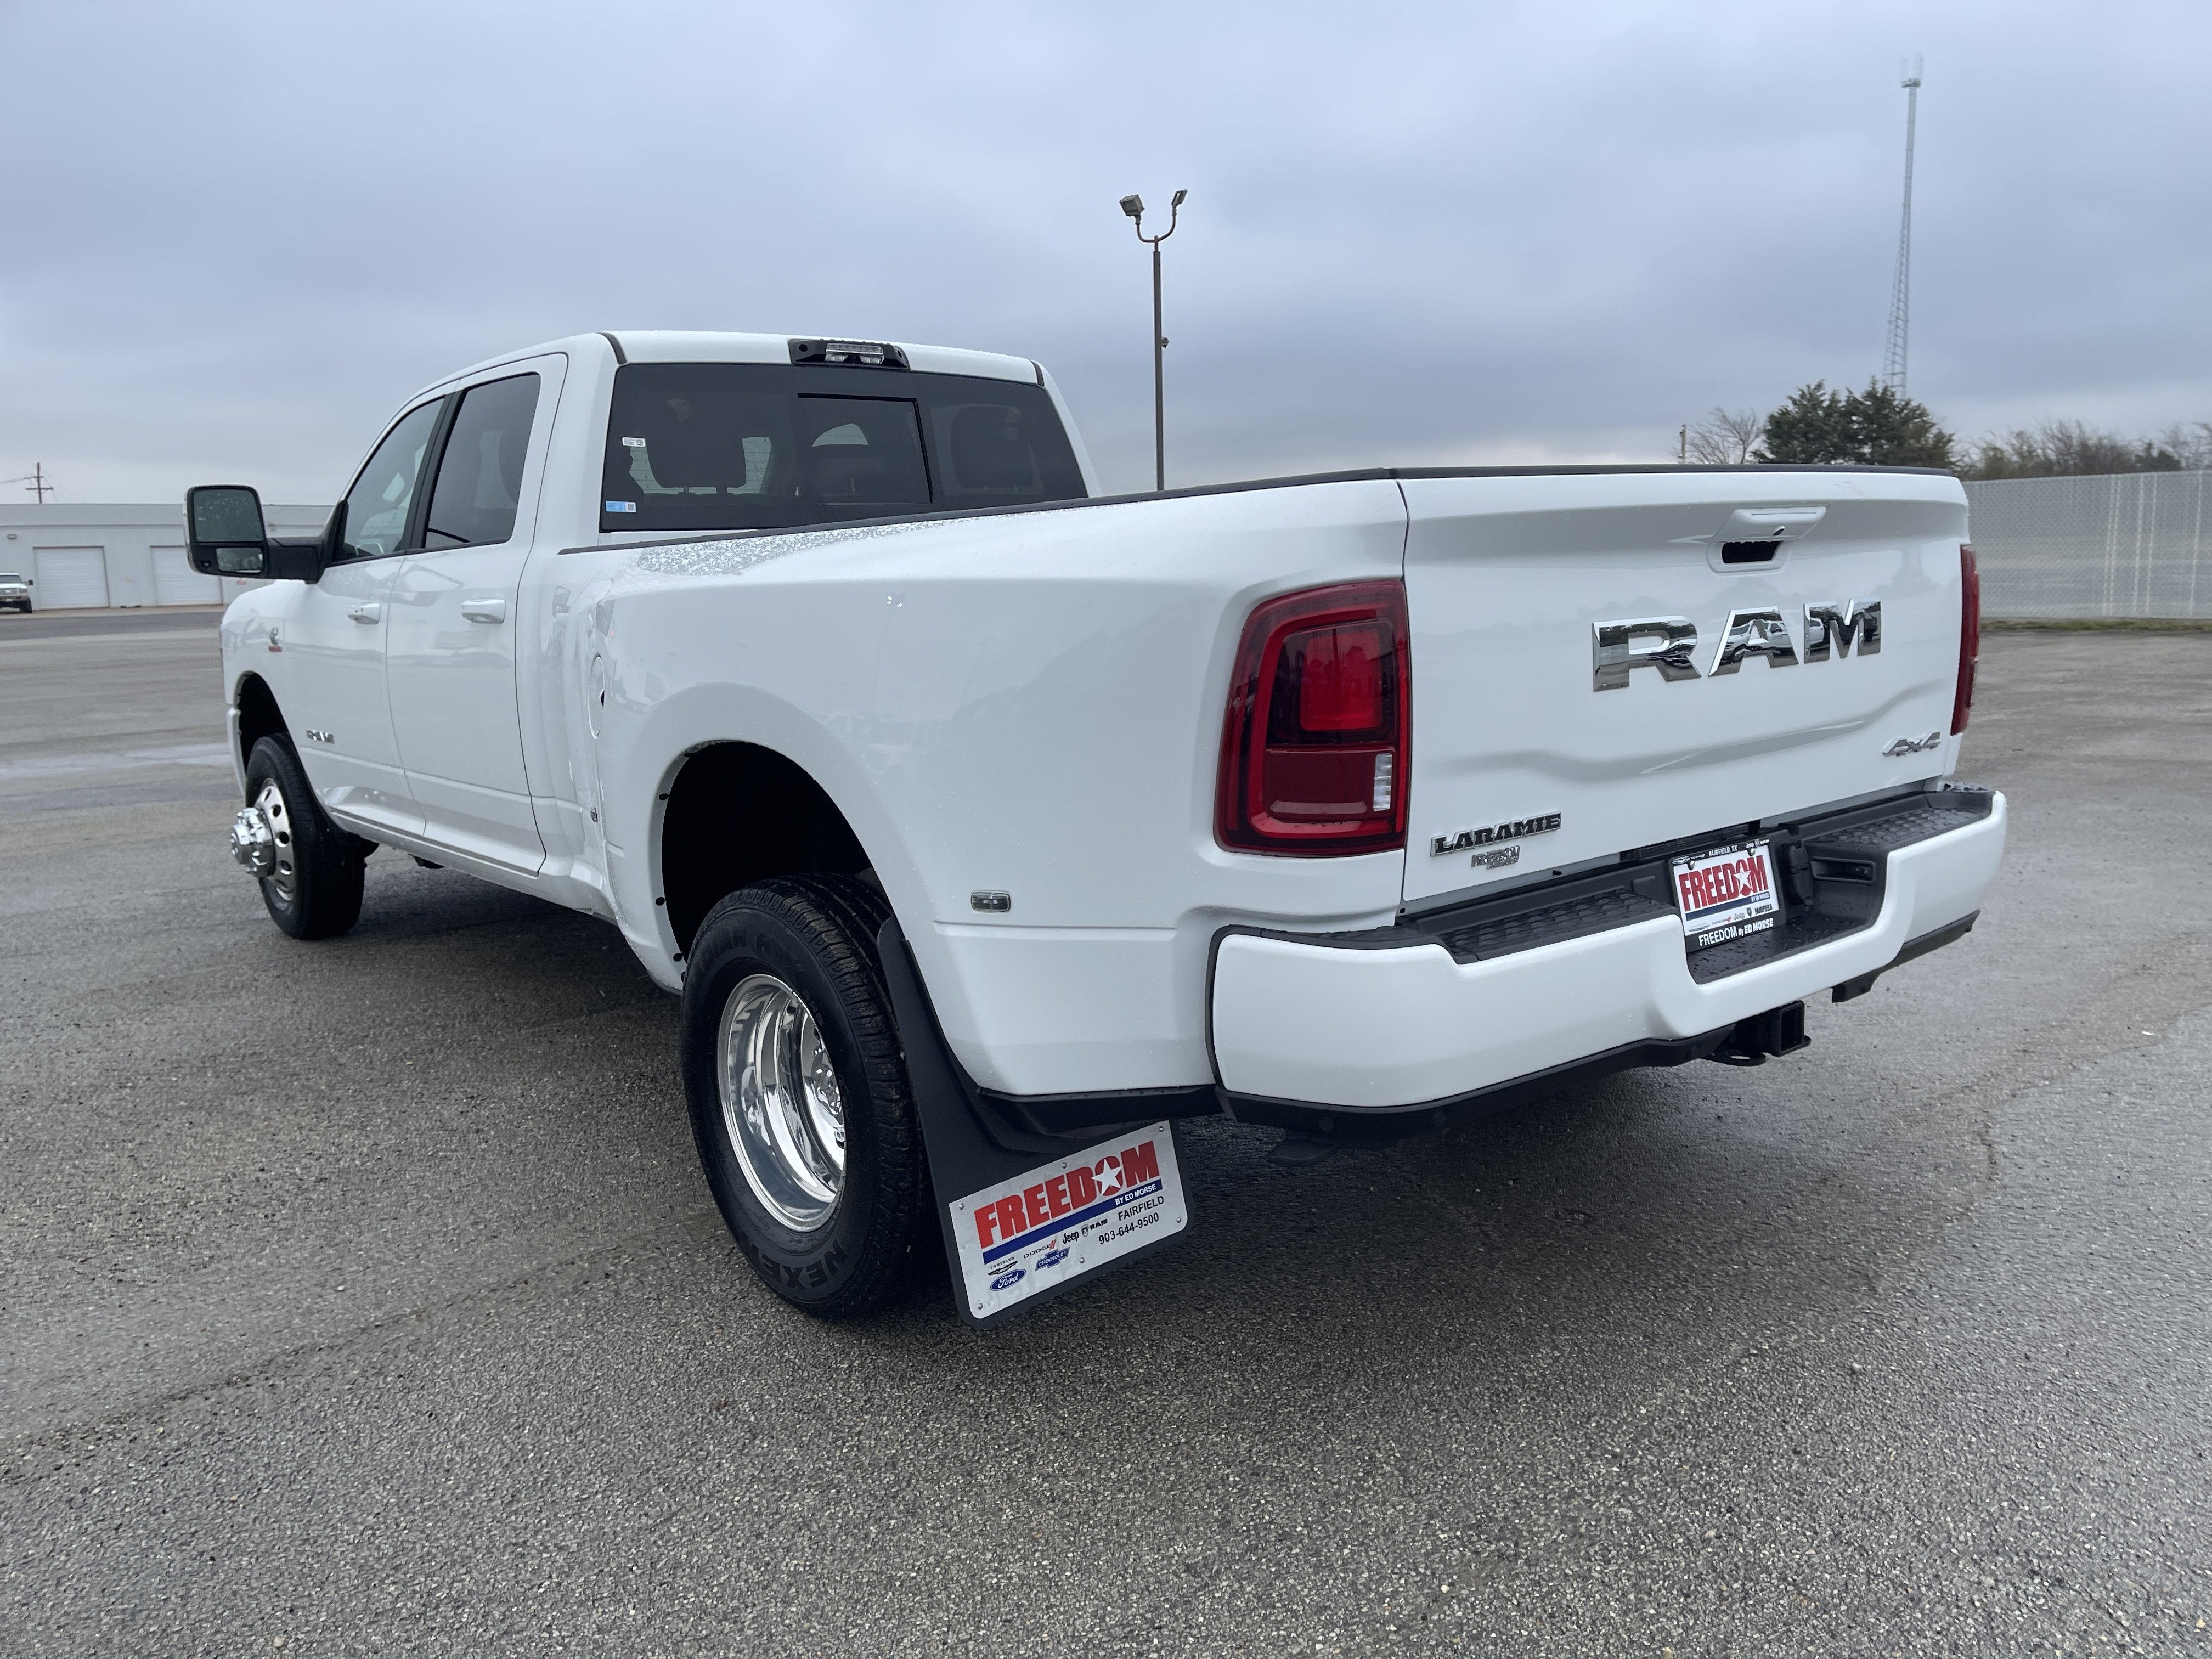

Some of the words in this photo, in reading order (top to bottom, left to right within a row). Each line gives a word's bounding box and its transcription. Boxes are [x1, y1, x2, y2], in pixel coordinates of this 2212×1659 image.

[1592, 599, 1882, 692] RAM
[1430, 812, 1561, 857] LARAMIE
[1678, 855, 1769, 912] FREEDOM
[1699, 926, 1738, 947] FREEDOM
[1743, 924, 1752, 933] ED
[1753, 918, 1774, 931] MORSE
[974, 1141, 1160, 1249] FREEDOM
[1115, 1197, 1124, 1205] BY
[1125, 1193, 1133, 1201] ED
[1135, 1183, 1156, 1197] MORSE
[1118, 1195, 1165, 1221] FAIRFIELD
[1063, 1231, 1080, 1244] Jeep
[1099, 1212, 1159, 1245] 903-644-9500
[1023, 1243, 1053, 1259] DODGE
[997, 1273, 1019, 1289] Ford
